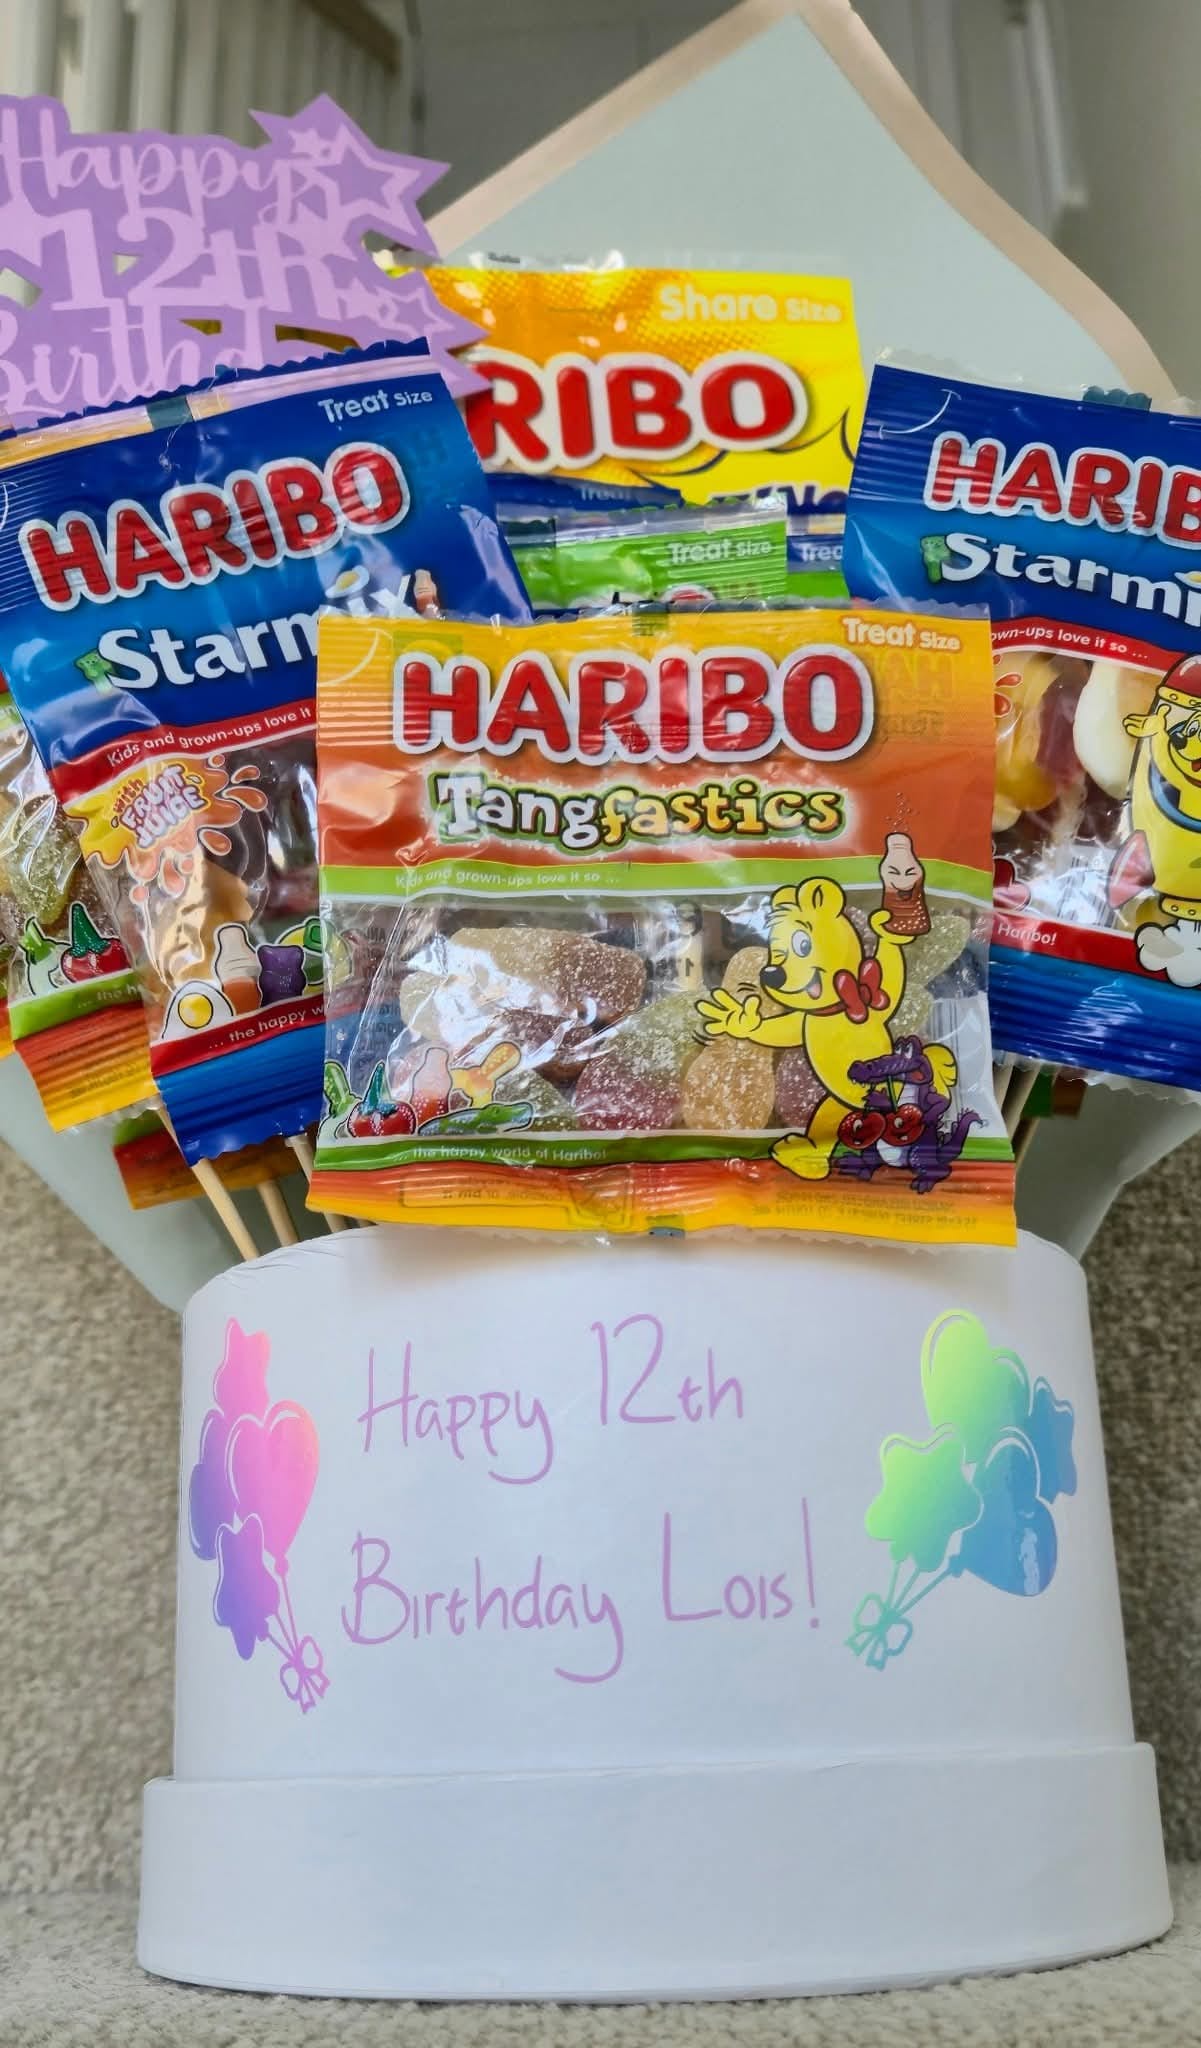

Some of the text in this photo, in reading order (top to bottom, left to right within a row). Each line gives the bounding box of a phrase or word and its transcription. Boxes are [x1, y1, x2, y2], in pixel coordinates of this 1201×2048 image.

[0, 107, 302, 227] Happy
[42, 207, 343, 320] 12th
[659, 284, 842, 322] Share Size
[318, 390, 391, 424] Treat
[924, 432, 1201, 550] HARIB
[19, 442, 408, 610] HARIBO
[668, 539, 733, 565] Treat
[842, 616, 916, 647] Treat
[1057, 629, 1091, 646] love
[1094, 635, 1106, 649] it
[1108, 640, 1128, 654] so
[106, 706, 313, 767] Kids and grown-ups love it
[394, 647, 875, 765] HARIBO
[120, 764, 188, 831] FRUIT
[134, 786, 206, 849] JUICE
[434, 773, 844, 850] Tangfastics
[424, 870, 451, 882] and
[456, 871, 533, 888] grown-ups
[537, 872, 566, 884] love
[570, 872, 580, 883] it
[583, 872, 600, 883] so
[998, 922, 1058, 947] Haribo!
[229, 1028, 255, 1043] the
[258, 1008, 307, 1033] happy
[440, 1145, 487, 1160] happy
[491, 1146, 531, 1159] world
[535, 1148, 549, 1160] of
[357, 1312, 745, 1485] Happy 12th
[341, 1496, 821, 1685] Birthday Lois!
